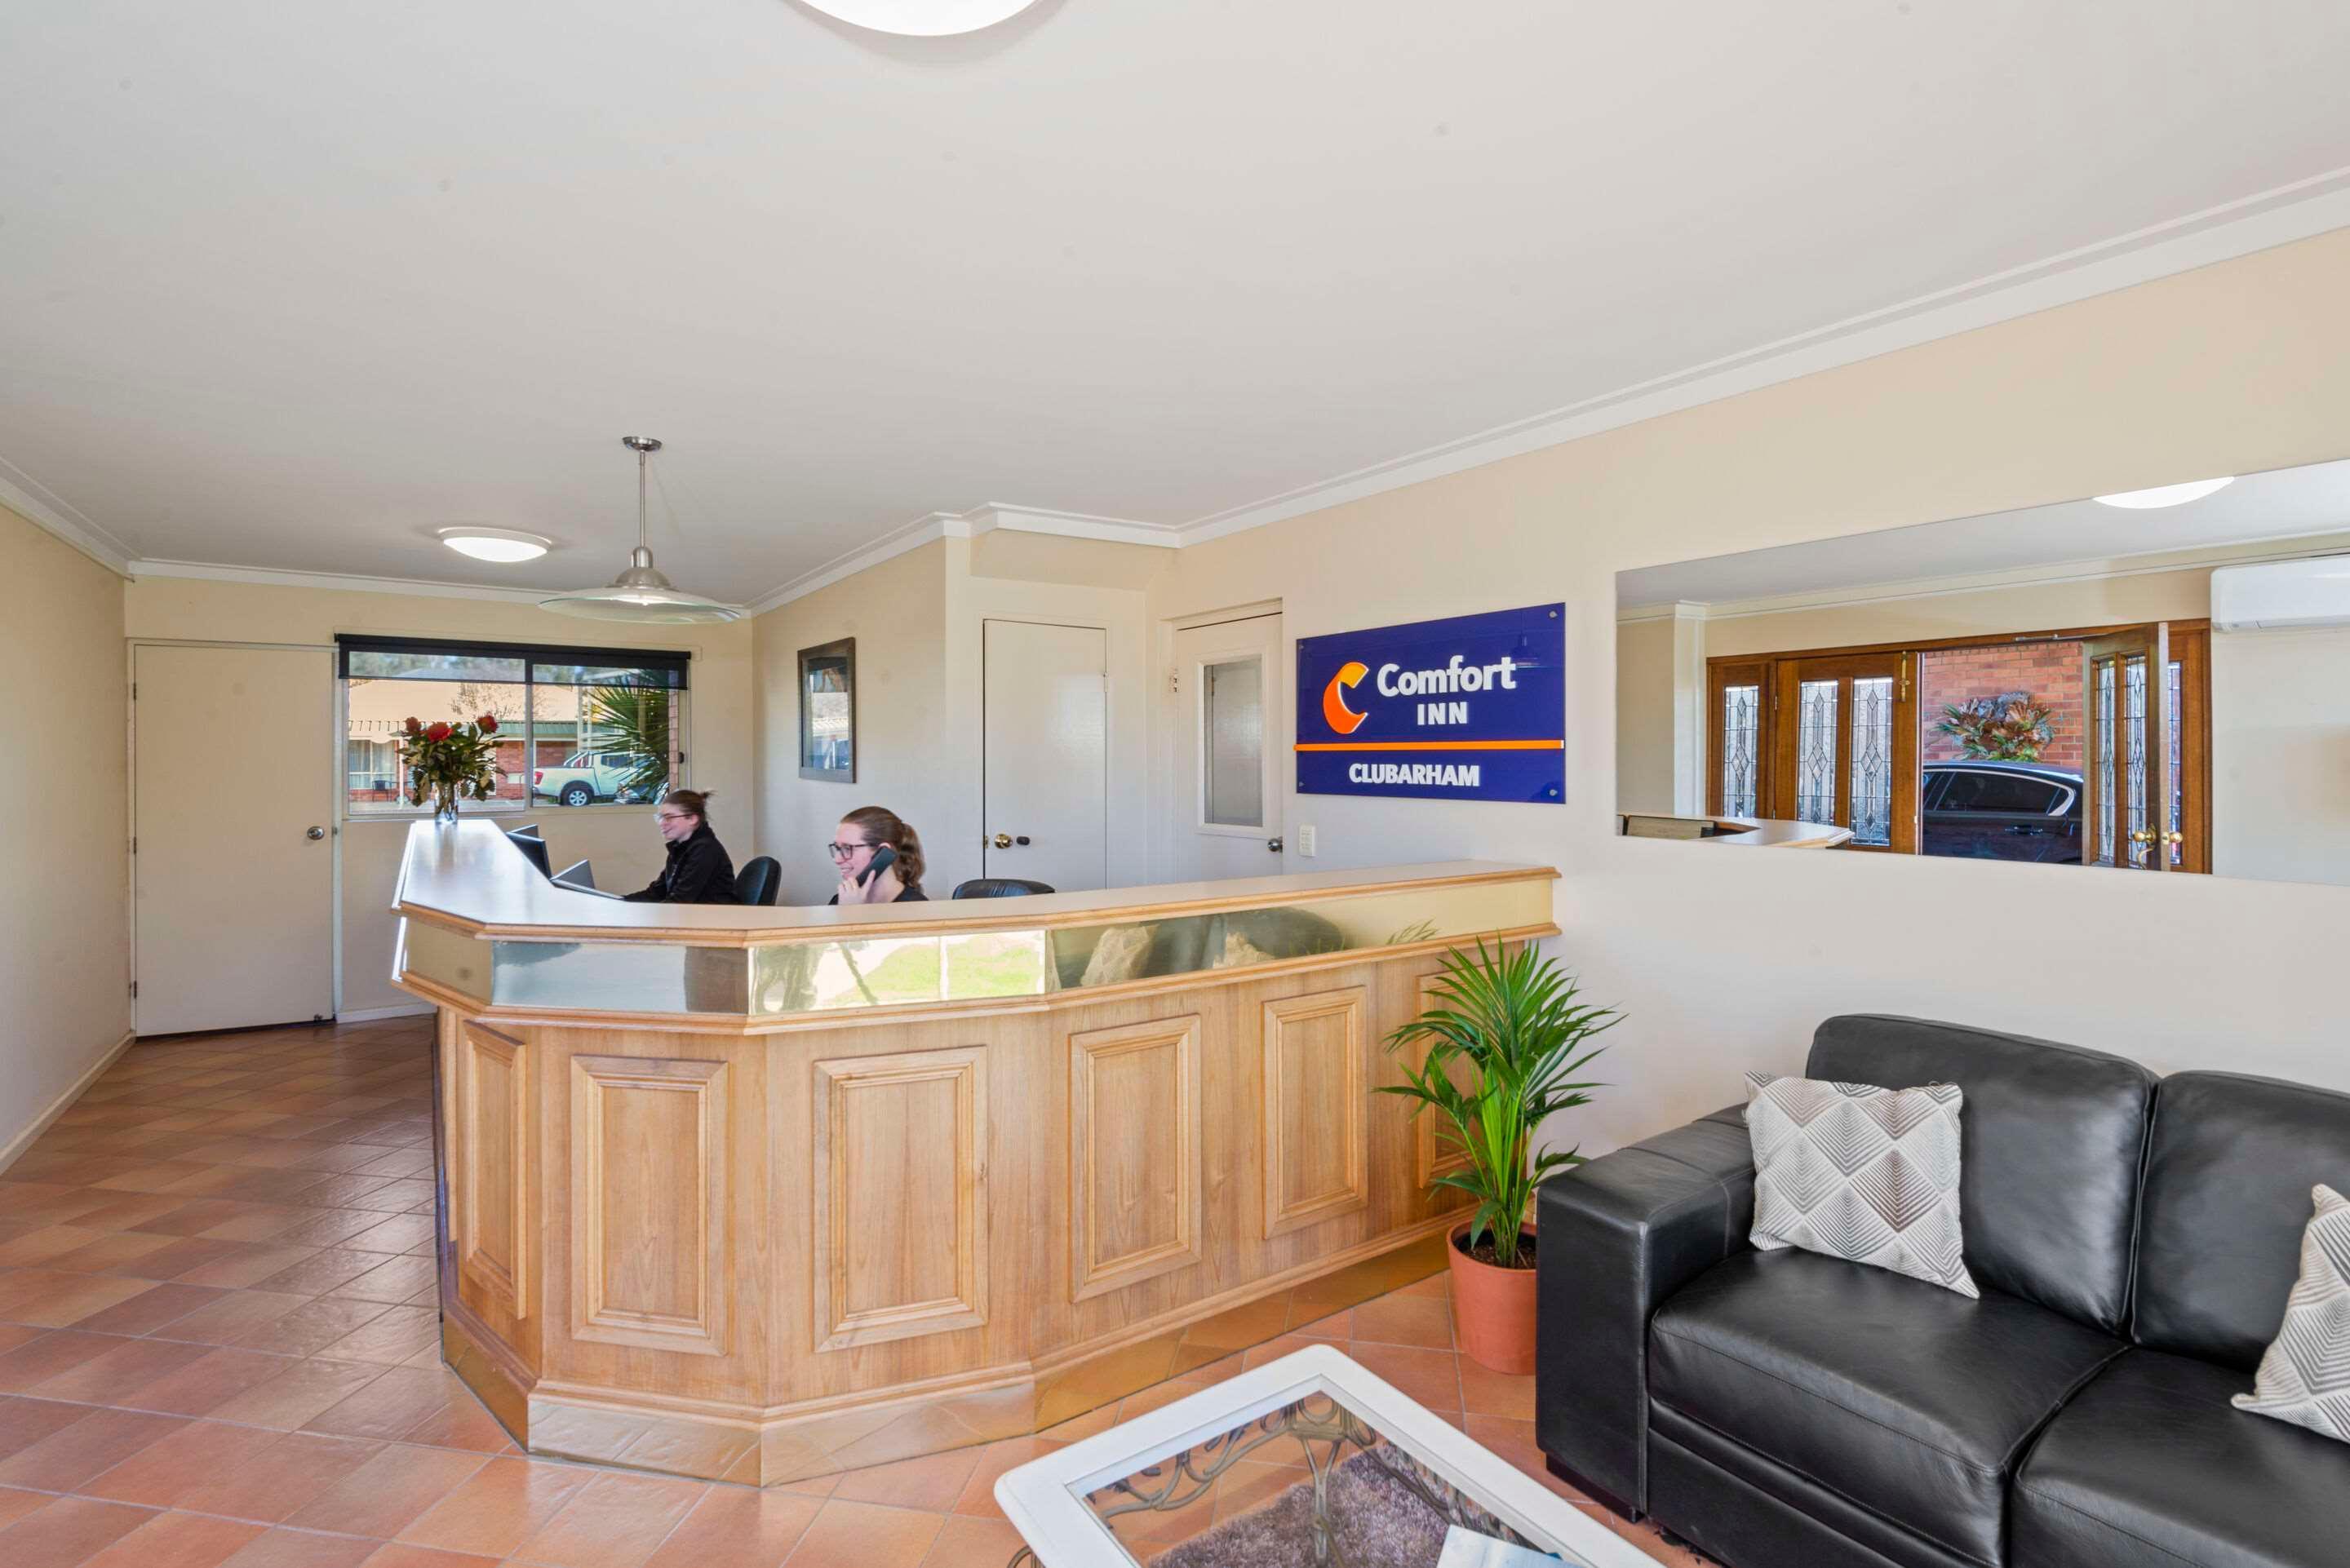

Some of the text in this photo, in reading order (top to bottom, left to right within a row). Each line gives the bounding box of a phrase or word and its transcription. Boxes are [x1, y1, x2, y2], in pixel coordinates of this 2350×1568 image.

[1377, 654, 1517, 698] Comfort
[1417, 701, 1468, 725] INN
[1348, 763, 1480, 787] CLUBARHAM
